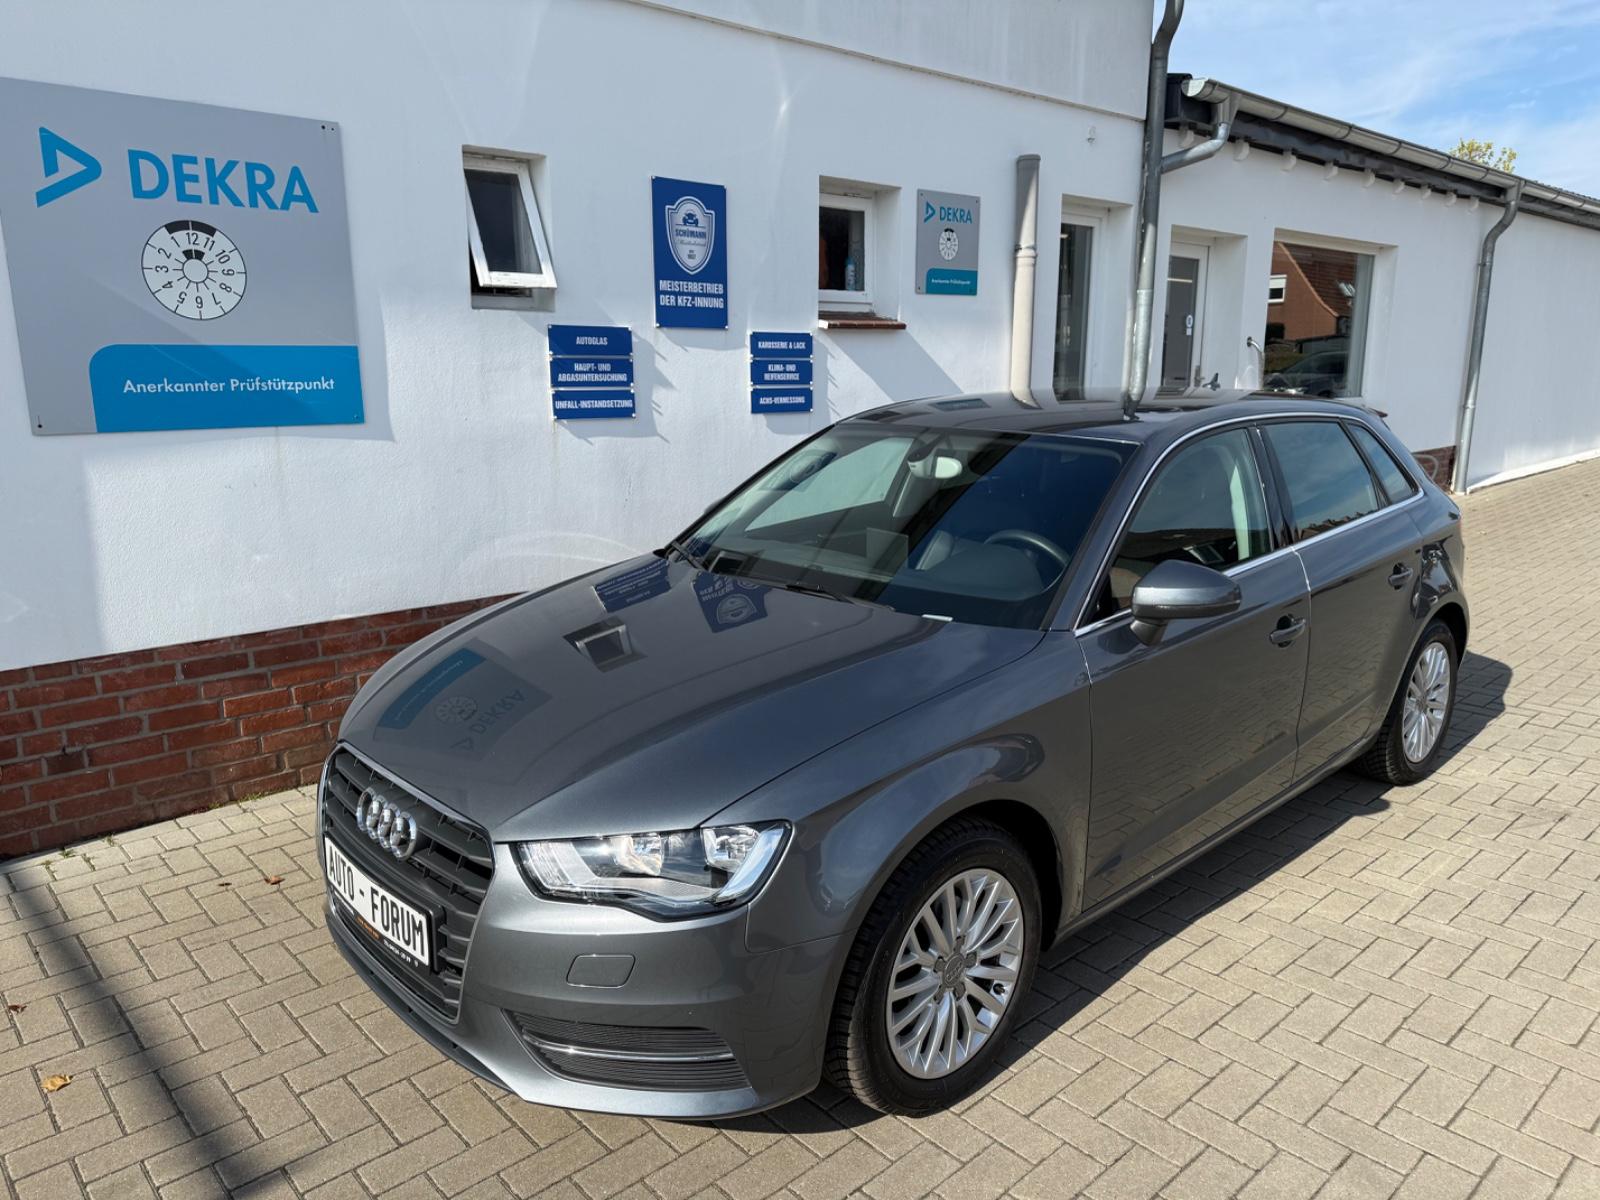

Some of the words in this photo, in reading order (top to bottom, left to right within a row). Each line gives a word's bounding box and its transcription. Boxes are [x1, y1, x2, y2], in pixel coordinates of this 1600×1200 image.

[127, 148, 319, 213] DEKRA
[939, 206, 972, 224] DEKRA
[170, 235, 181, 248] 1
[186, 232, 200, 246] 12
[203, 237, 215, 251] 11
[157, 247, 172, 259] 2
[215, 249, 230, 264] 10
[154, 265, 169, 273] 3
[162, 280, 174, 289] 4
[219, 282, 232, 293] 8
[659, 280, 724, 294] MEISTERBETRIEB
[176, 291, 187, 304] 5
[211, 292, 221, 305] 7
[660, 295, 676, 306] DER
[677, 296, 724, 309] KFZ-INNUNG
[576, 336, 608, 345] AUTOGLAS
[574, 363, 597, 371] HAUPT-
[598, 363, 611, 371] UND
[557, 373, 628, 382] ABGASUNTERSUCHUNG
[122, 379, 226, 394] Anerkannter
[230, 376, 335, 394] Prüfstützpunkt
[555, 400, 633, 409] UNFALL-INSTANDSETZUNG
[328, 845, 355, 901] AUTO
[370, 886, 425, 958] FORUM
